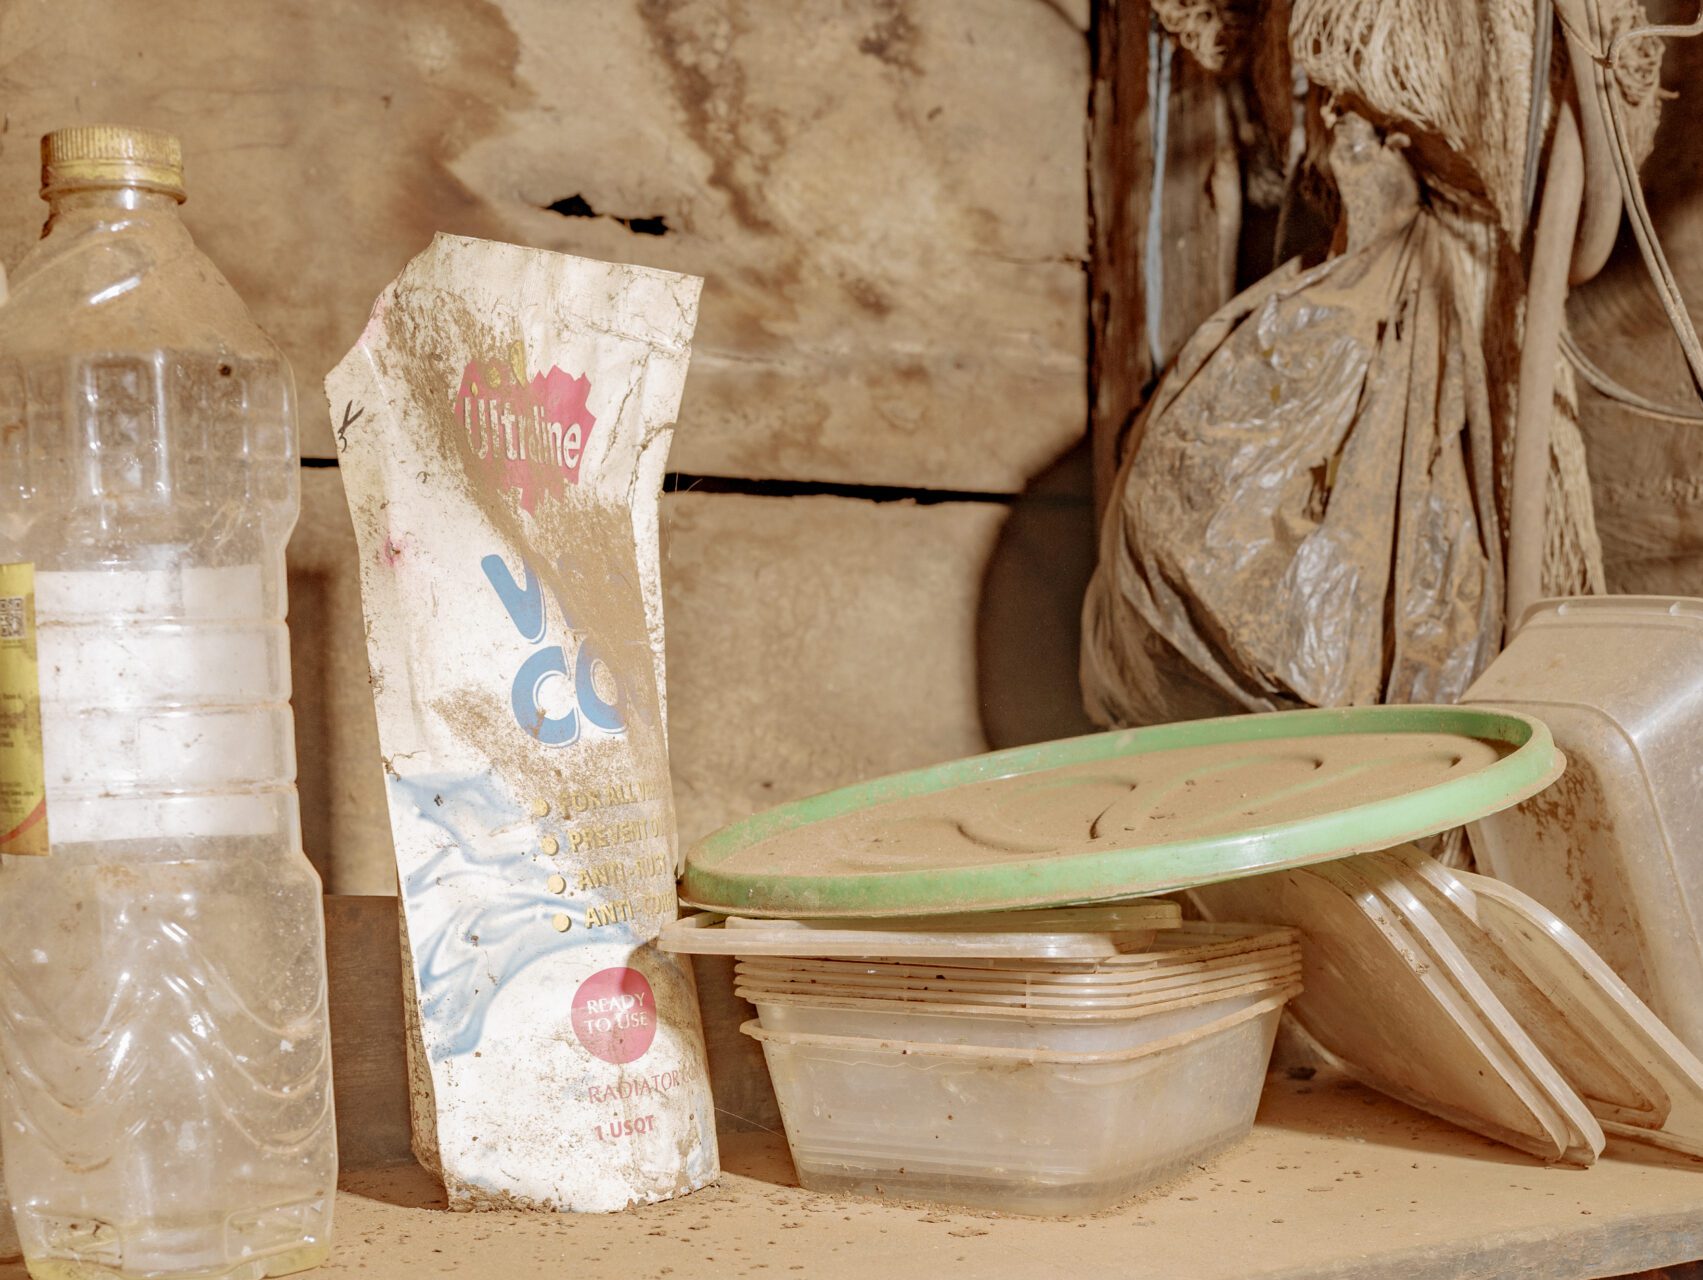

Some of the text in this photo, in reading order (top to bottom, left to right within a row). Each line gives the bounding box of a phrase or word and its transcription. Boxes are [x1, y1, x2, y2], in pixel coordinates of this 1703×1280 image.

[606, 782, 638, 807] ALL
[586, 991, 646, 1015] READY
[584, 1011, 649, 1035] TO USE
[588, 1070, 680, 1104] RADIATOR
[594, 1115, 655, 1141] 1 USQT
